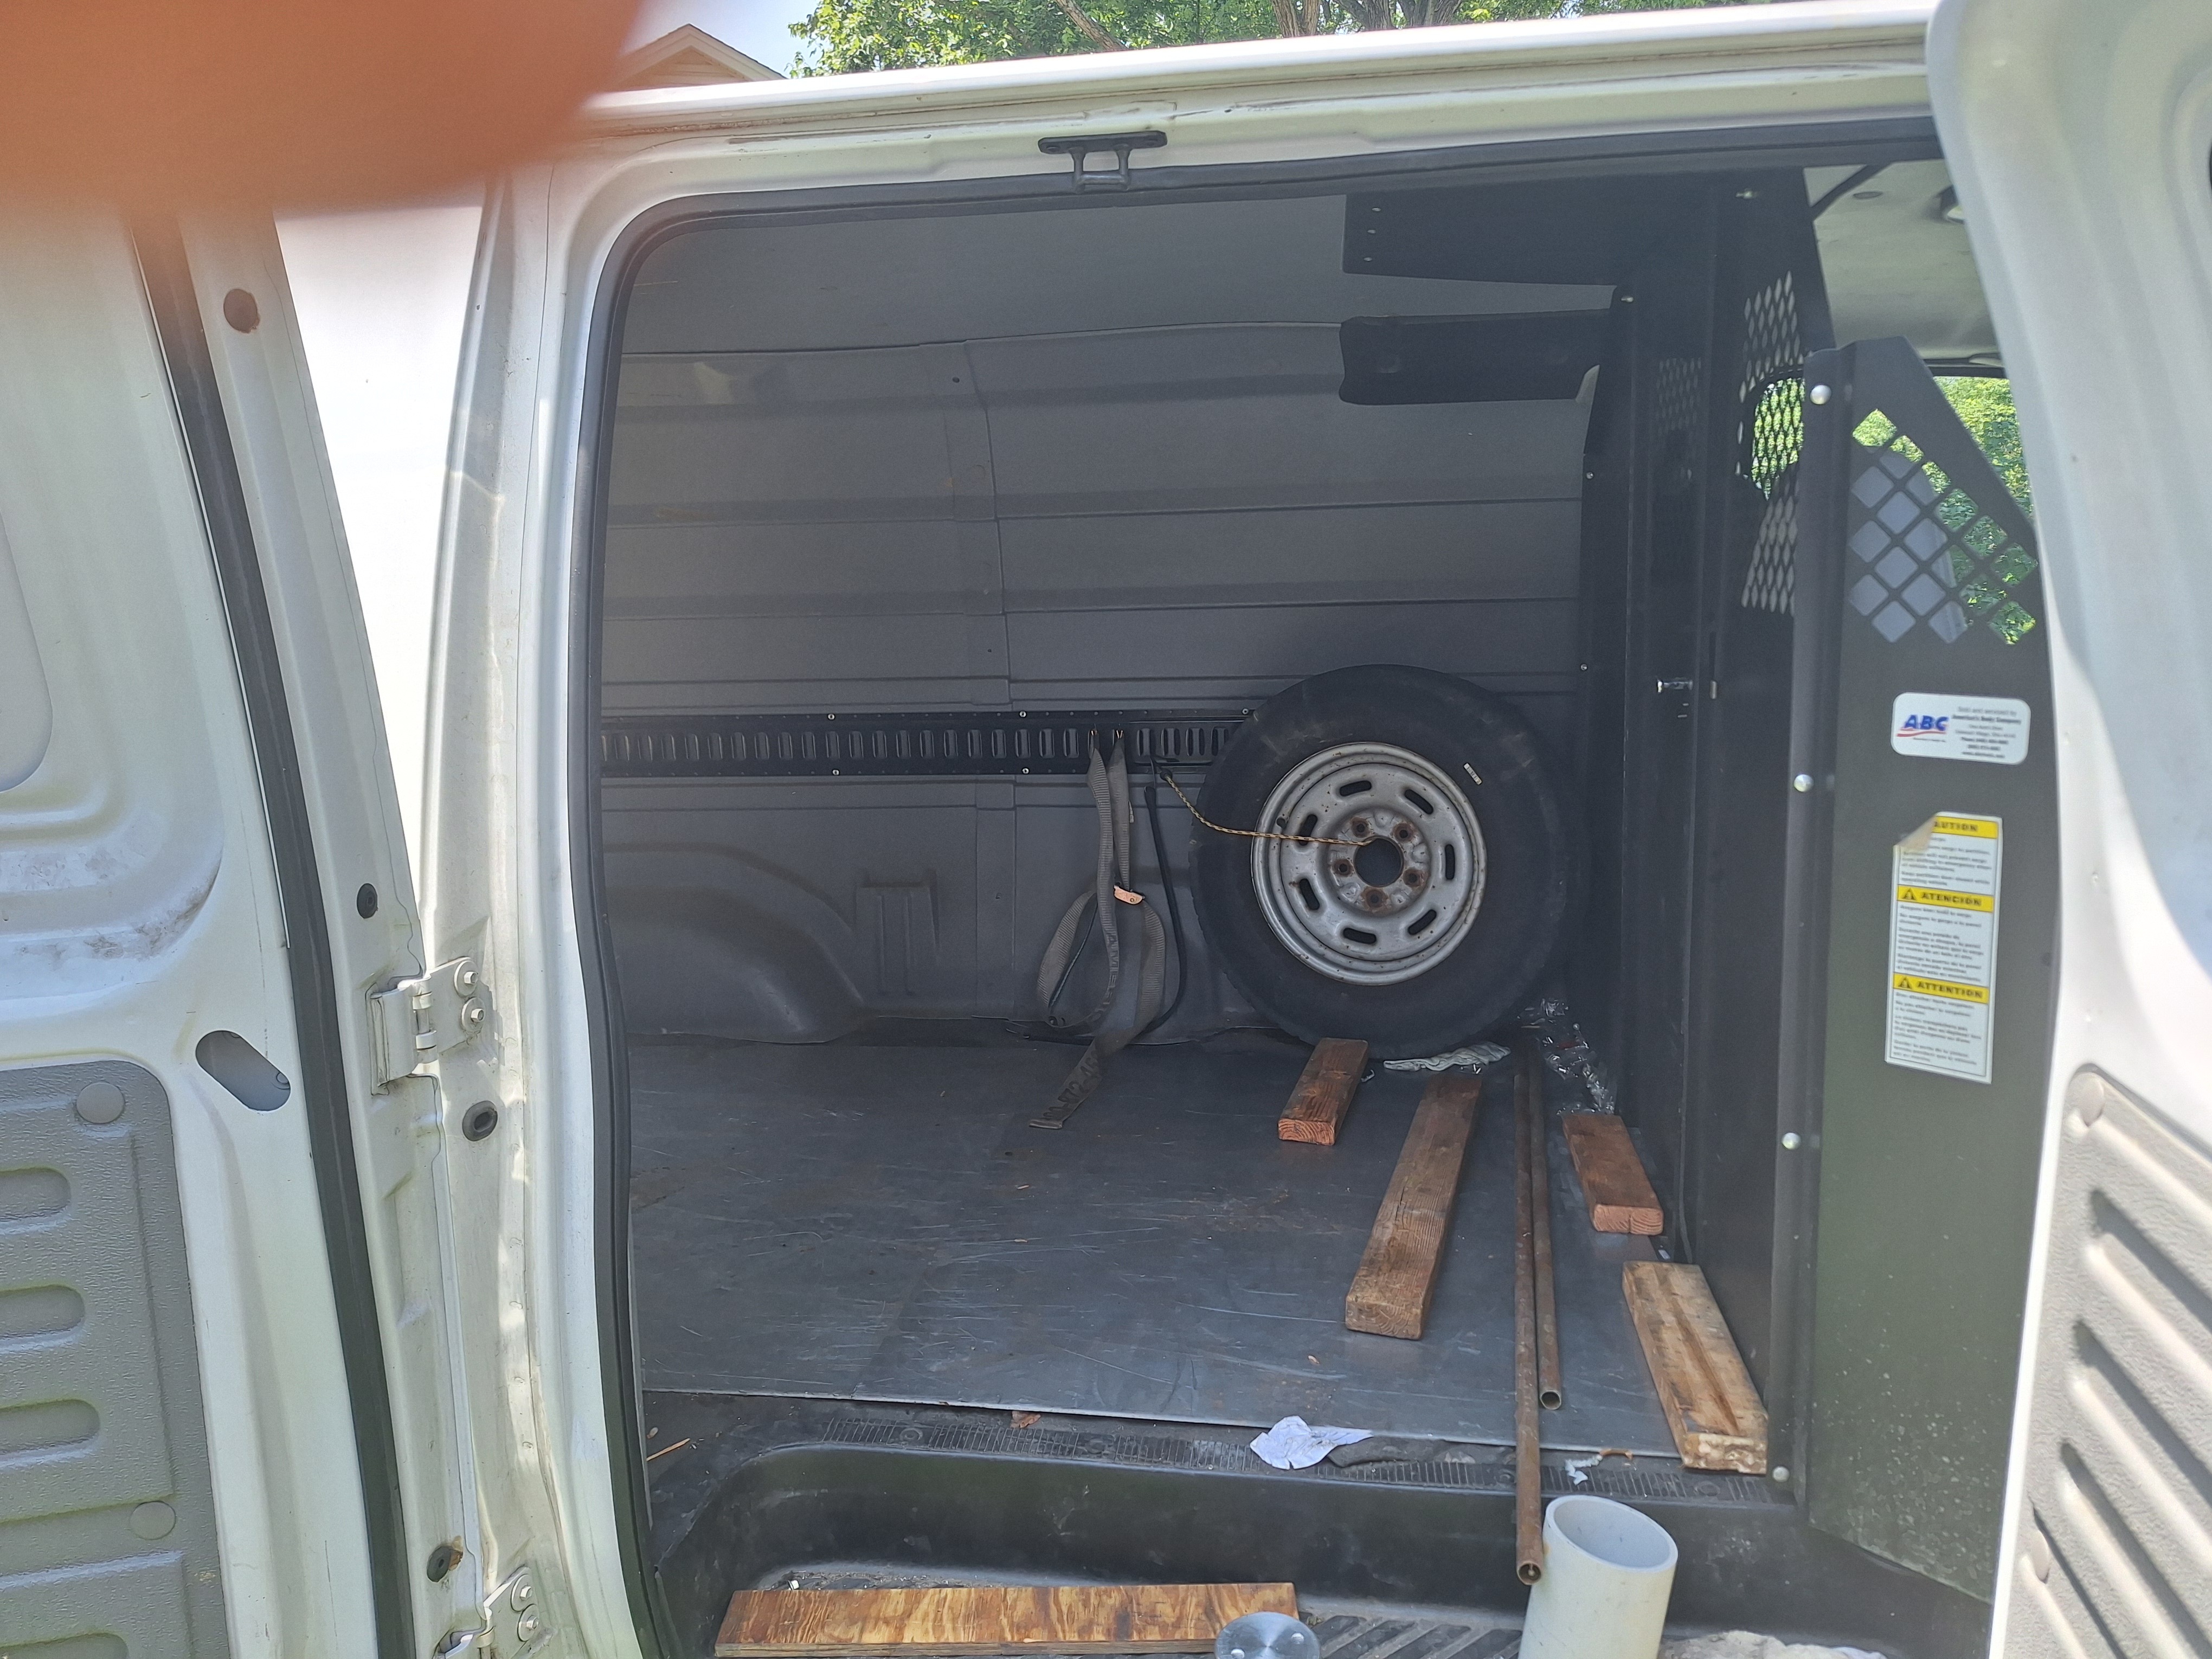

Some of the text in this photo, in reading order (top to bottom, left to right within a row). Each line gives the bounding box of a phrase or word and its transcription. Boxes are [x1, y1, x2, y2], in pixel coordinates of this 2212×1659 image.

[1904, 714, 1949, 731] ABC
[1934, 821, 1978, 832] AUTION
[1917, 981, 1983, 998] ATTENTION
